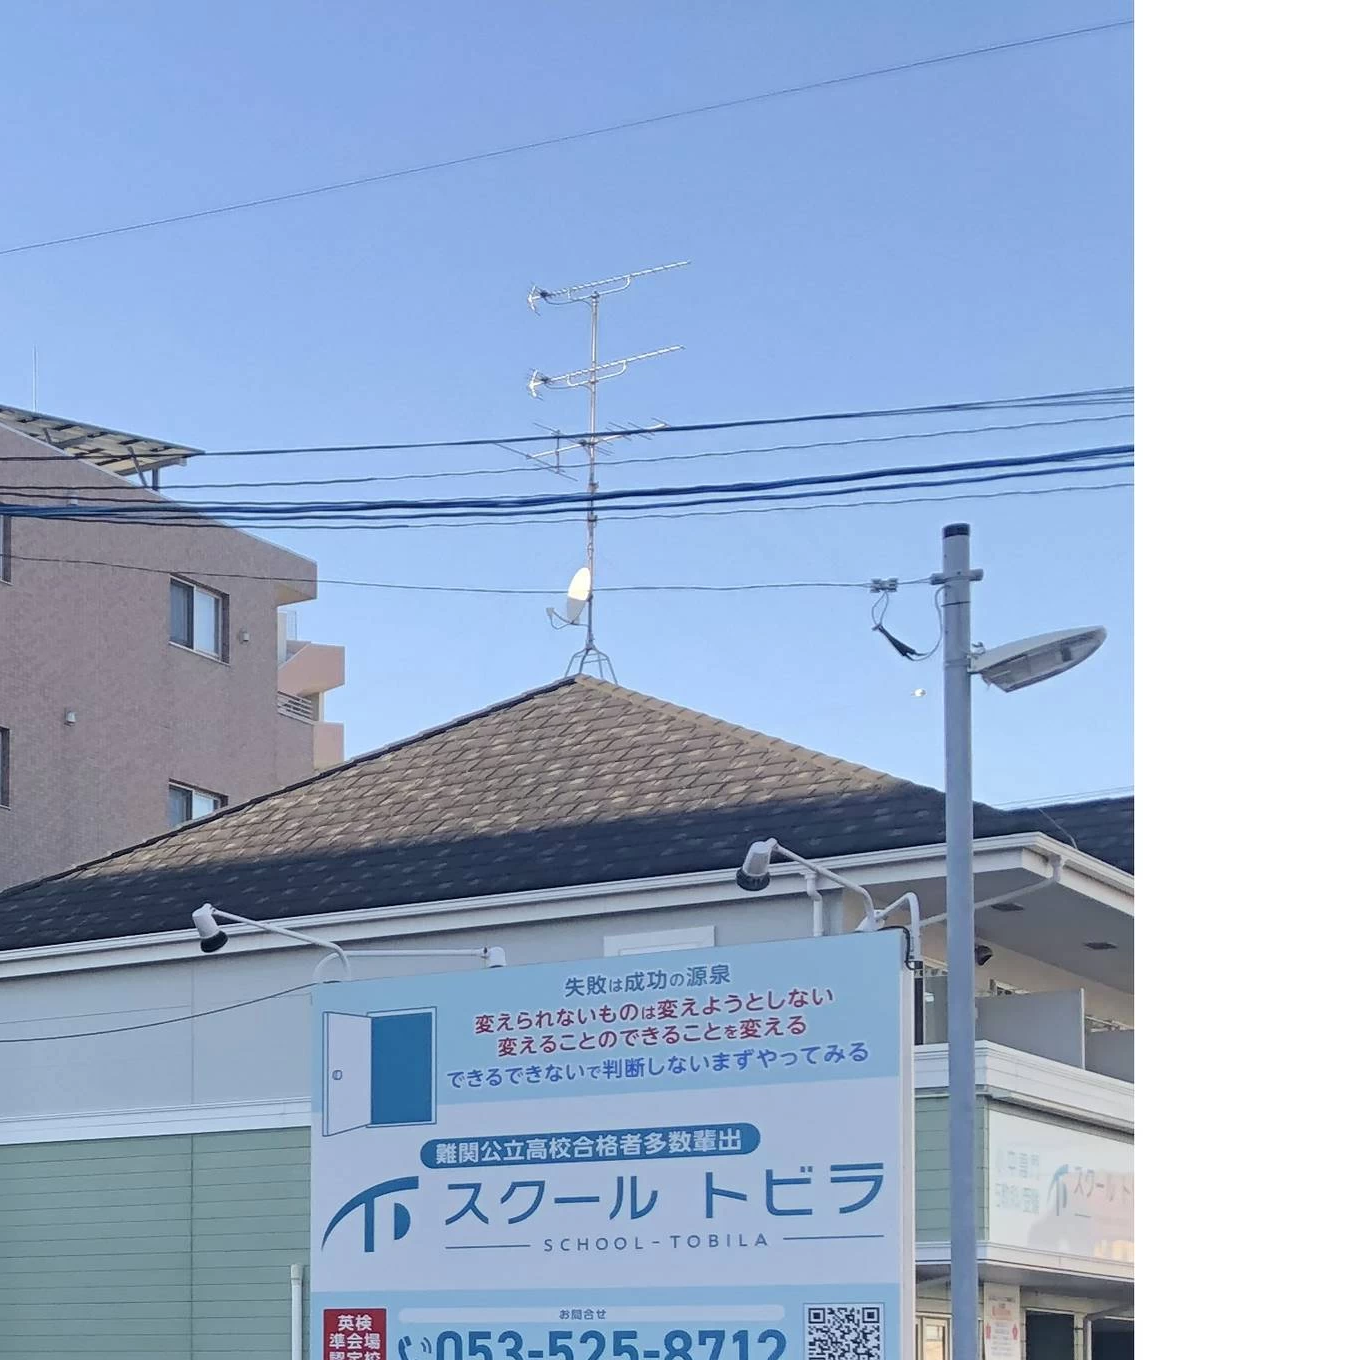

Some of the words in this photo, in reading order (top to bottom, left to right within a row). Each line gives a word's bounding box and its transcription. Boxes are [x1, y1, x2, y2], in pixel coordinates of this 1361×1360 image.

[564, 964, 731, 998] 失敗は成功の源泉
[474, 987, 834, 1035] 変えられないものは変えようとしない
[497, 1015, 807, 1057] 変えることのできることを変える
[446, 1042, 869, 1090] できるできないで判断しないまずやってみる
[434, 1129, 743, 1165] 難関公立高校合格者多数輩出
[444, 1174, 658, 1226] スクール
[704, 1162, 884, 1220] トビラ
[543, 1232, 770, 1253] SCHOOL-TOBILA
[337, 1313, 372, 1331] 英検
[558, 1308, 607, 1321] お問合せ
[329, 1332, 381, 1350] 準会場
